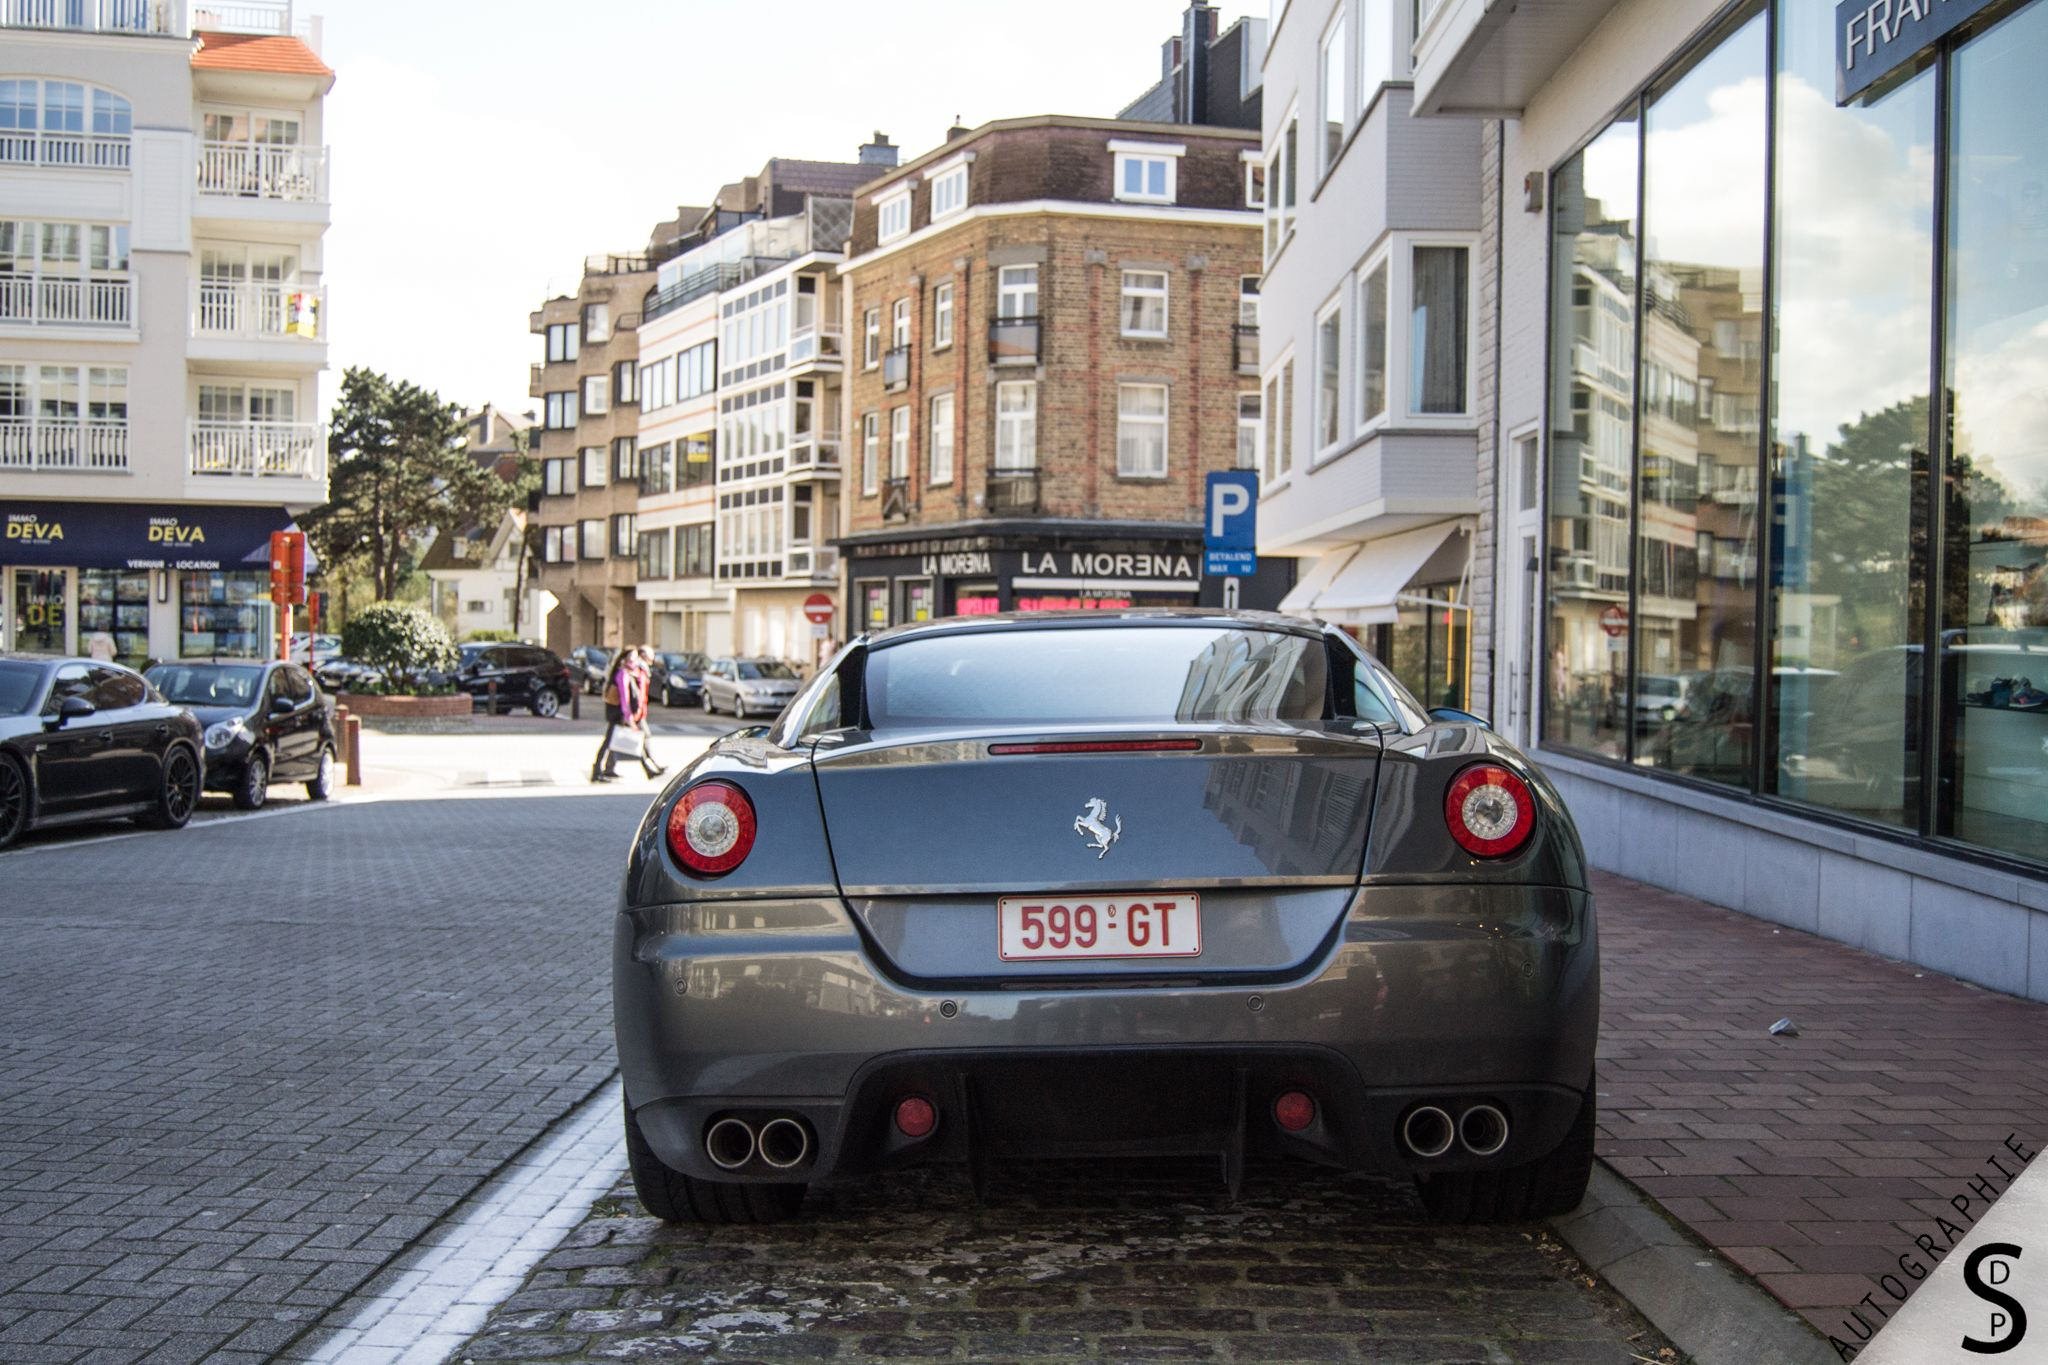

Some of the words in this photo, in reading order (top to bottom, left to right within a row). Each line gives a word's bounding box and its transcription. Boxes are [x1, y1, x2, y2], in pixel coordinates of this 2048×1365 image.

[1212, 484, 1250, 537] P
[6, 522, 65, 540] DEVA
[148, 526, 206, 543] DEVA
[176, 560, 220, 570] LOCATION
[922, 555, 938, 575] LA
[1022, 552, 1058, 575] LA
[1071, 553, 1193, 578] MORENA
